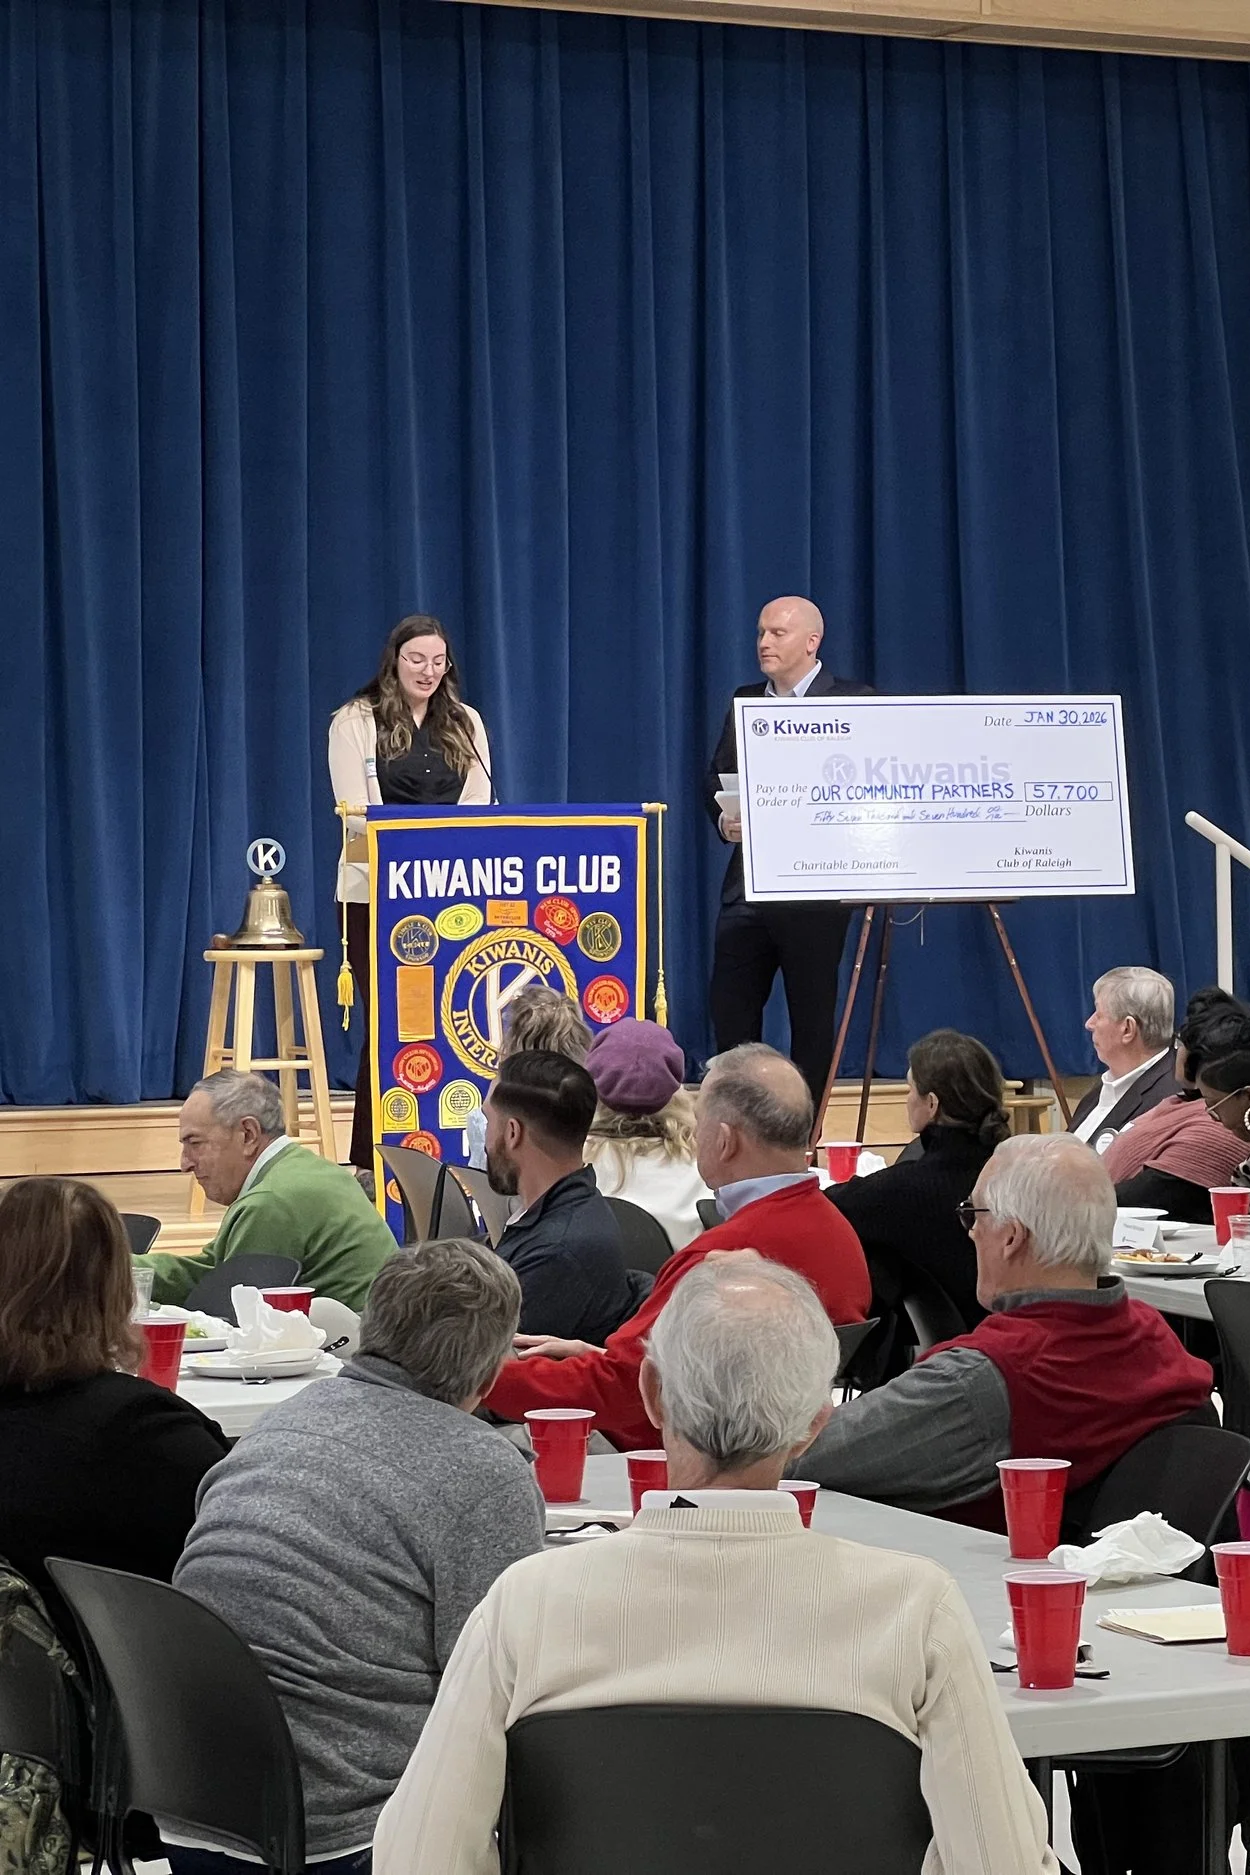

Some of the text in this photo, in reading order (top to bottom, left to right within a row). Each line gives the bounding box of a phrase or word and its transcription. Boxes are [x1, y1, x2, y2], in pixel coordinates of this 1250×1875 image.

[984, 715, 1012, 727] Date
[1024, 711, 1054, 724] JAN
[773, 719, 851, 735] Kiwanis
[864, 755, 1011, 786] Kiwanis
[756, 783, 807, 795] Pay to the
[811, 782, 1014, 801] OUR COMMUNITY PARTNERS
[756, 796, 803, 808] Order of
[920, 810, 945, 820] Seven
[1025, 804, 1072, 817] Dollars
[1014, 847, 1053, 856] Kiwanis
[793, 860, 899, 871] Charitable Donation
[996, 858, 1072, 869] Club of Raleigh
[388, 855, 621, 899] KIWANIS CLUB
[465, 940, 555, 978] KIWANIS
[452, 1008, 499, 1069] INTER
